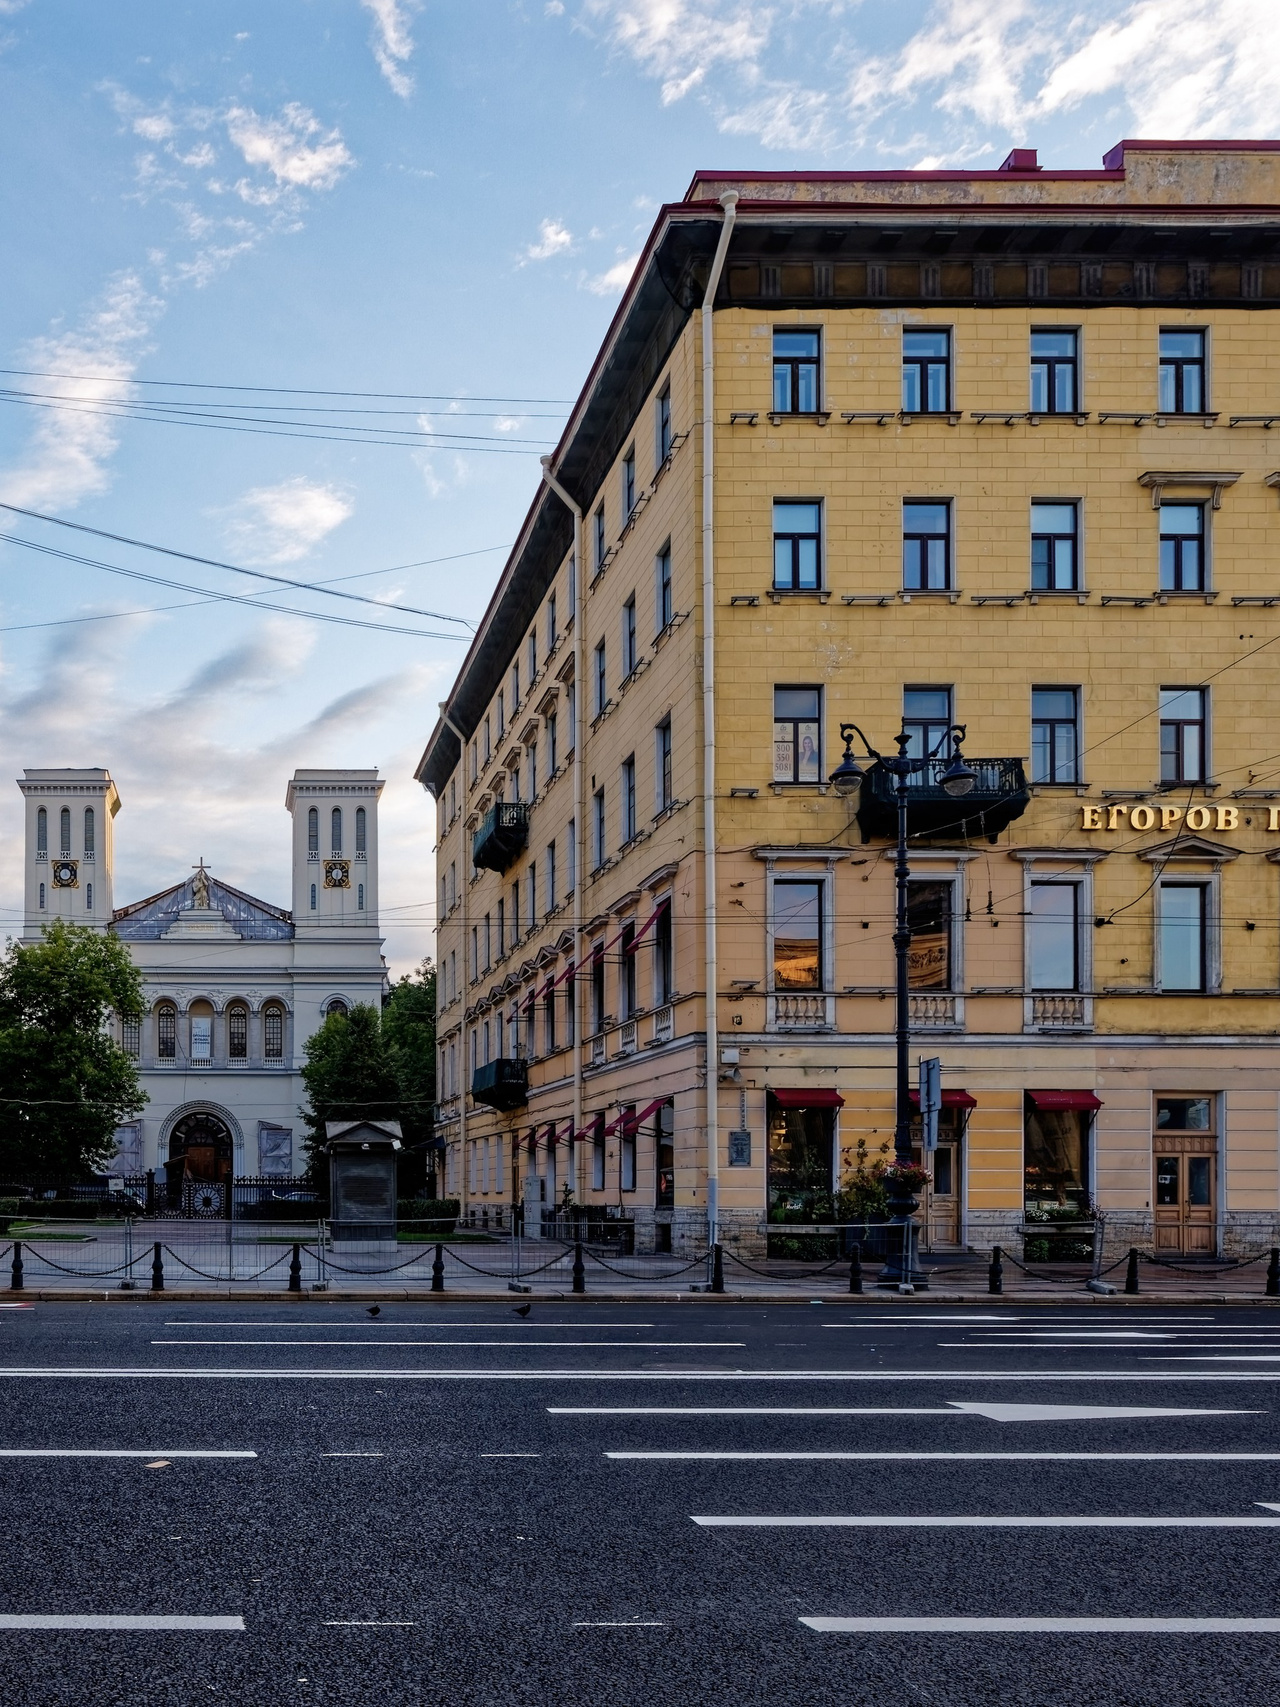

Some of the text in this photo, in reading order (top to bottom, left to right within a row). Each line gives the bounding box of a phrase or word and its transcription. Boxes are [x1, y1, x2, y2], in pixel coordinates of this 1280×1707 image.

[776, 744, 790, 752] 800
[776, 754, 790, 762] 550
[775, 763, 791, 771] 5081
[1081, 805, 1239, 830] ЕГОРОВ
